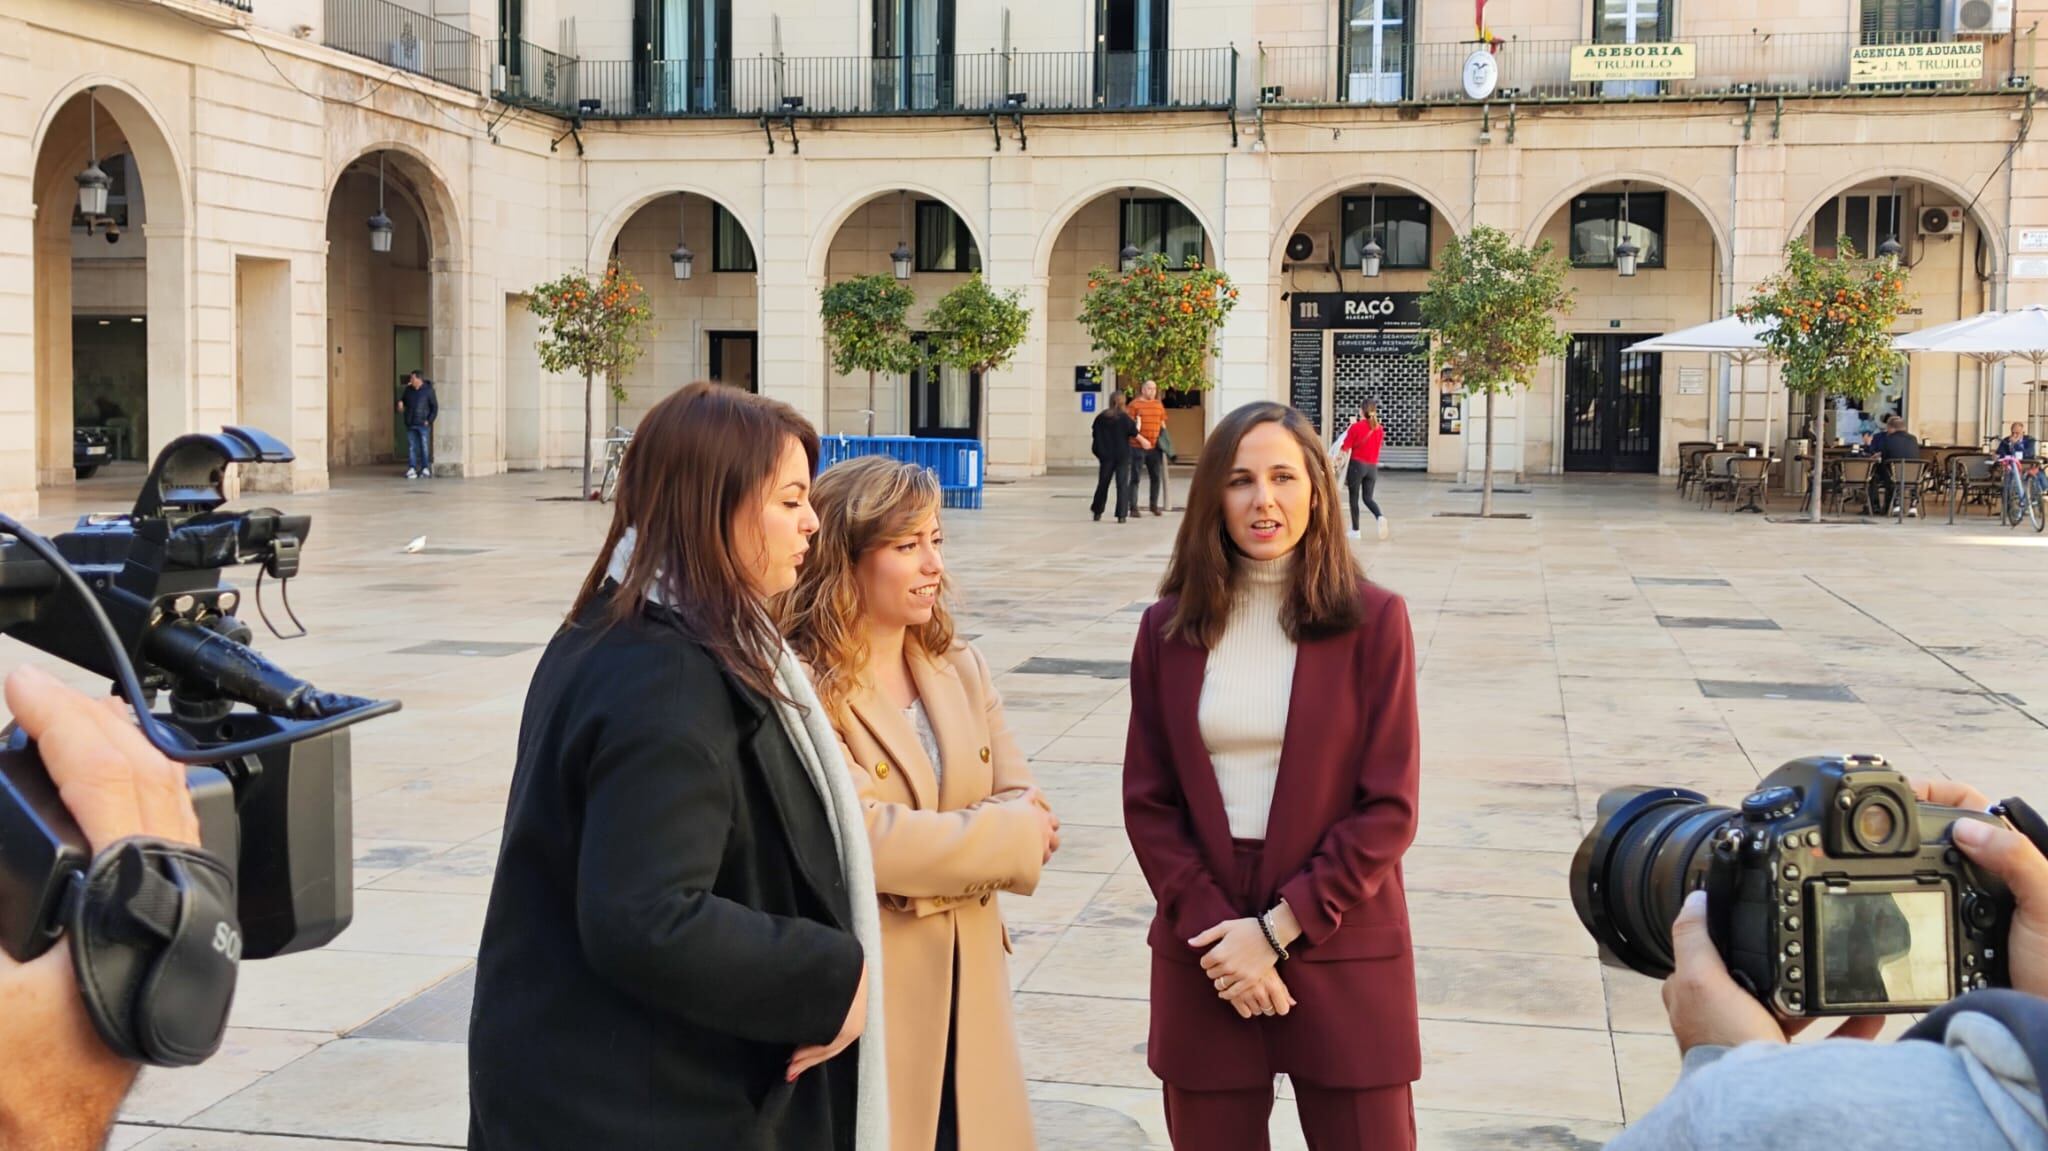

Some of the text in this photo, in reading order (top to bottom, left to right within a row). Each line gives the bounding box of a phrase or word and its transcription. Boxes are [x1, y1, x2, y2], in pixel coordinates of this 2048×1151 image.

[1583, 46, 1683, 58] ASESORIA
[1853, 45, 1982, 59] AGENCIA DE ADUANAS
[1595, 59, 1673, 70] TRUJILLO
[1897, 60, 1912, 71] M.
[1917, 58, 1982, 70] TRUJILLO
[1344, 296, 1394, 315] RACÓ
